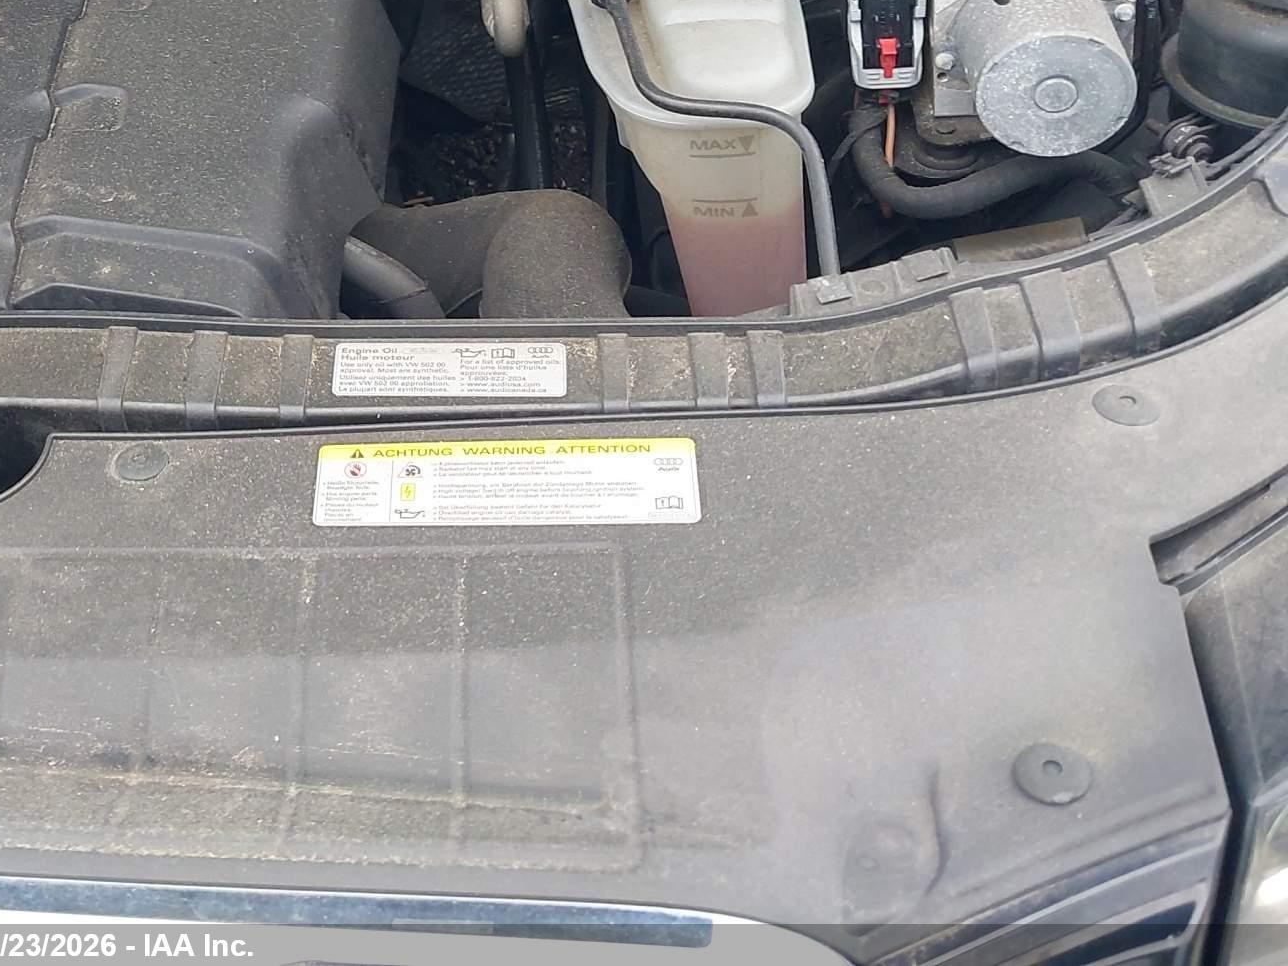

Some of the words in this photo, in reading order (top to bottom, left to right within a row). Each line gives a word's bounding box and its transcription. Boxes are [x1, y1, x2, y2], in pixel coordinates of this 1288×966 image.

[689, 139, 737, 151] MAX
[693, 206, 736, 218] MIN
[341, 347, 379, 357] Engine
[372, 448, 453, 458] ACHTUNG
[463, 446, 546, 456] WARNING
[554, 444, 652, 454] ATTENTION
